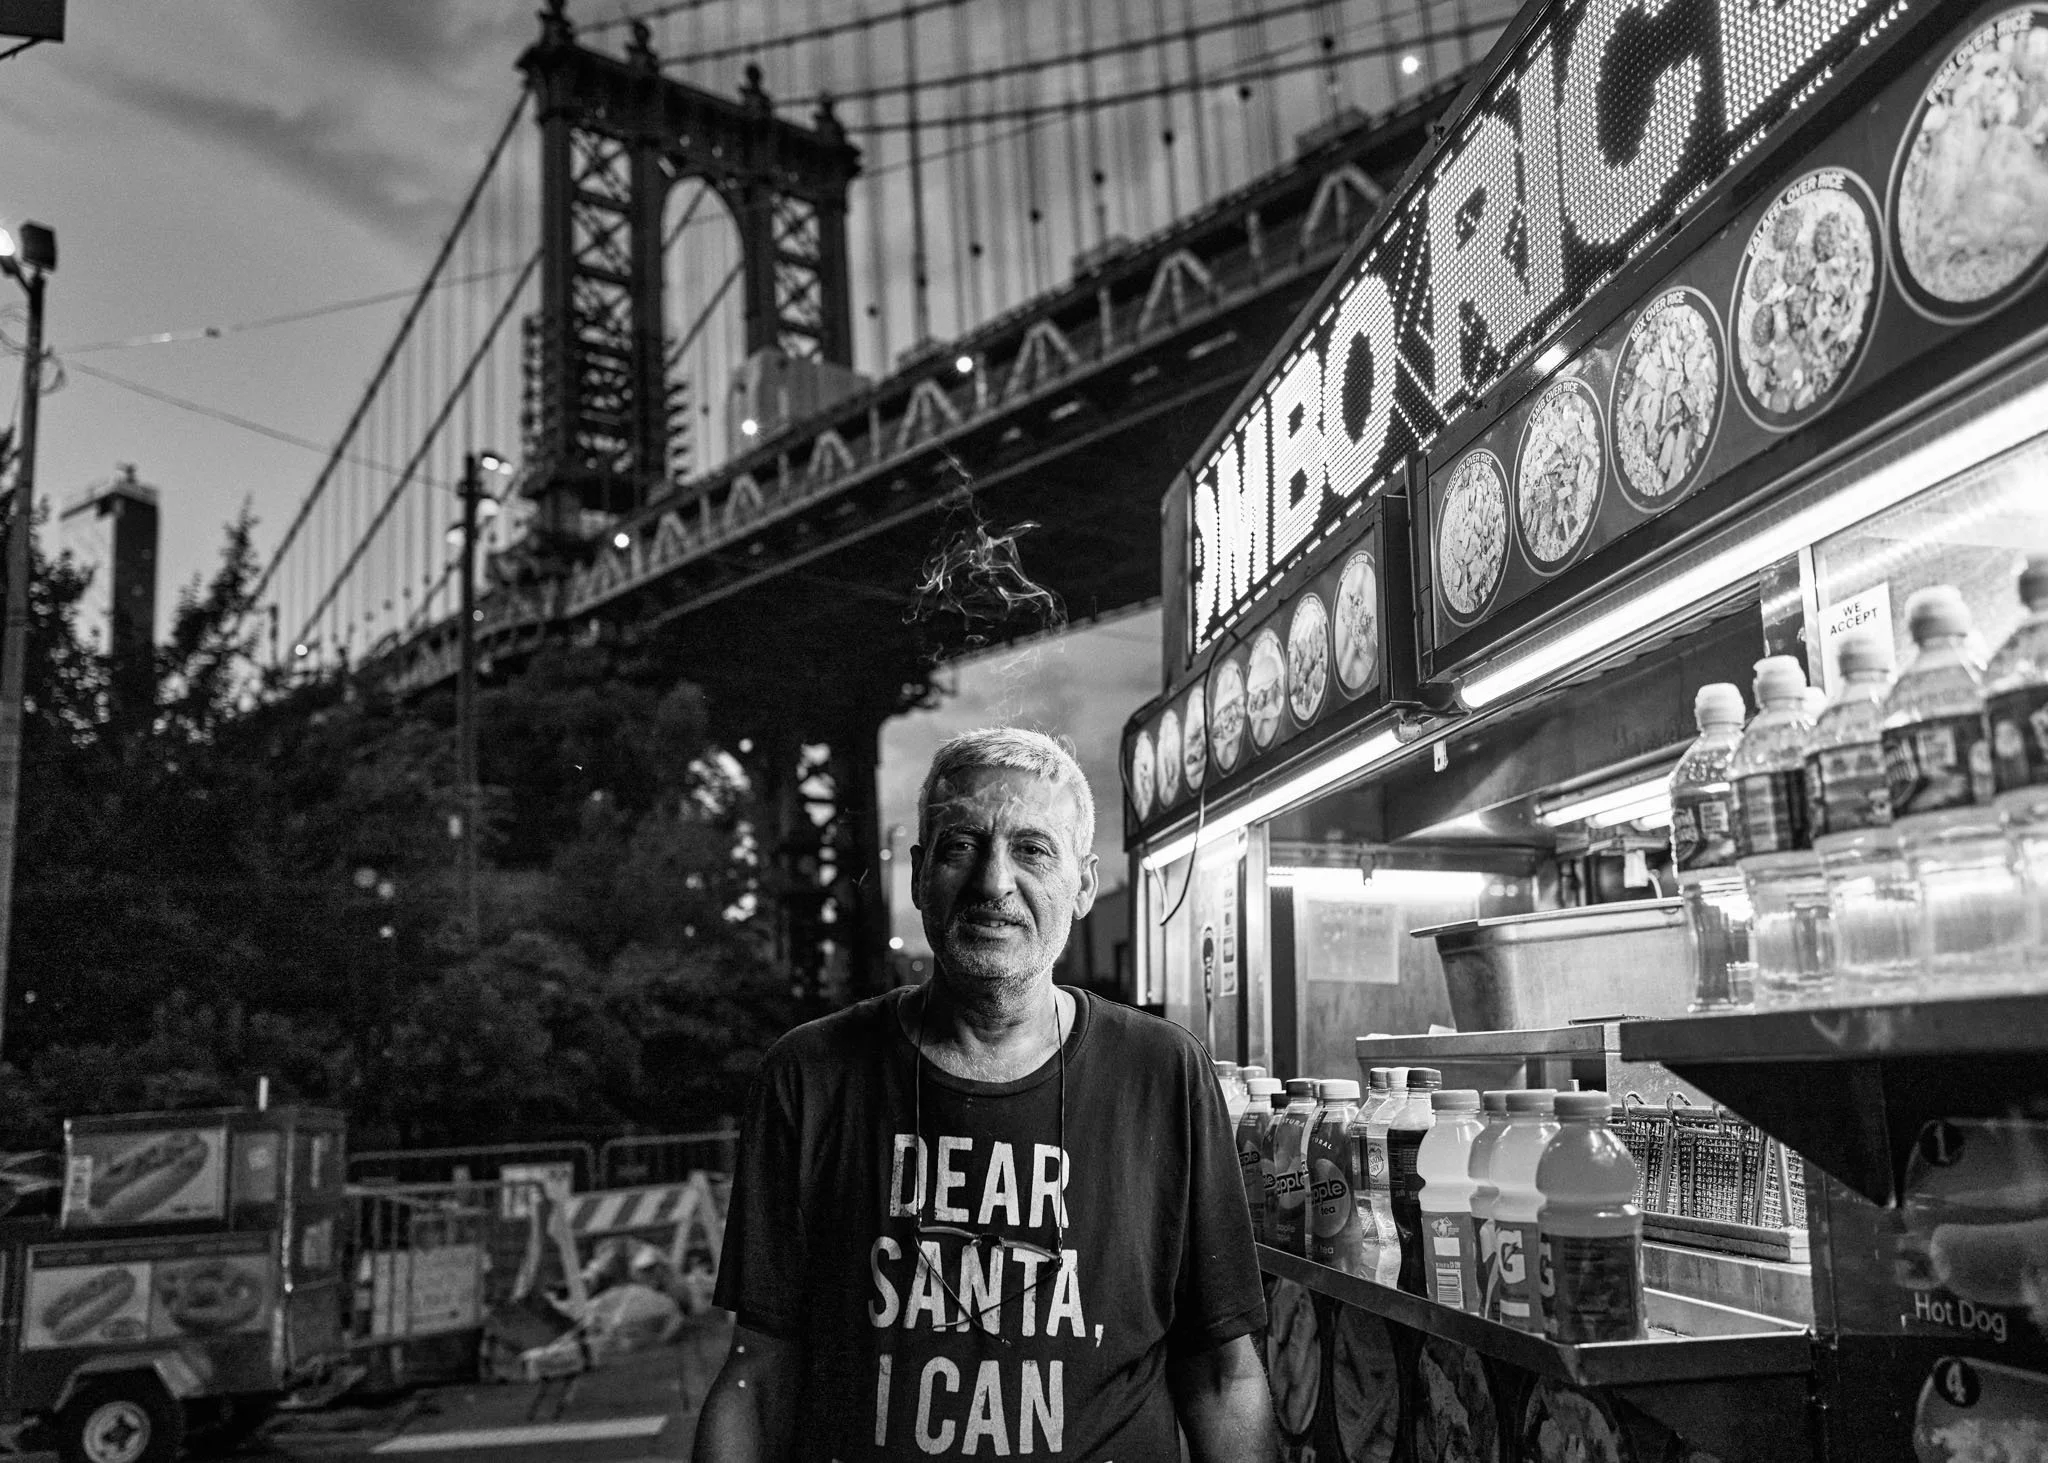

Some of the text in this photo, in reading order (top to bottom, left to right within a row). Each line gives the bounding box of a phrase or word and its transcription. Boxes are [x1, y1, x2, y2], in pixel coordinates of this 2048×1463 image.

[1956, 26, 1996, 65] OVER
[1996, 11, 2034, 36] RICE
[1747, 172, 1846, 257] FALAFEL OVER RICE
[1630, 290, 1685, 342] MIX OVER RICE
[1529, 381, 1579, 428] LAMB OVER RICE
[1445, 453, 1493, 498] CHICKEN OVER RICE
[1830, 607, 1877, 636] ACCEPT
[1843, 602, 1861, 616] WE
[889, 1133, 1070, 1229] DEAR
[1321, 1206, 1335, 1215] tea
[1498, 1228, 1526, 1285] G
[868, 1235, 1104, 1349] SANTA,
[1914, 1290, 2007, 1343] Hot Dog
[875, 1353, 1066, 1456] I CAN
[1945, 1361, 1966, 1403] 4
